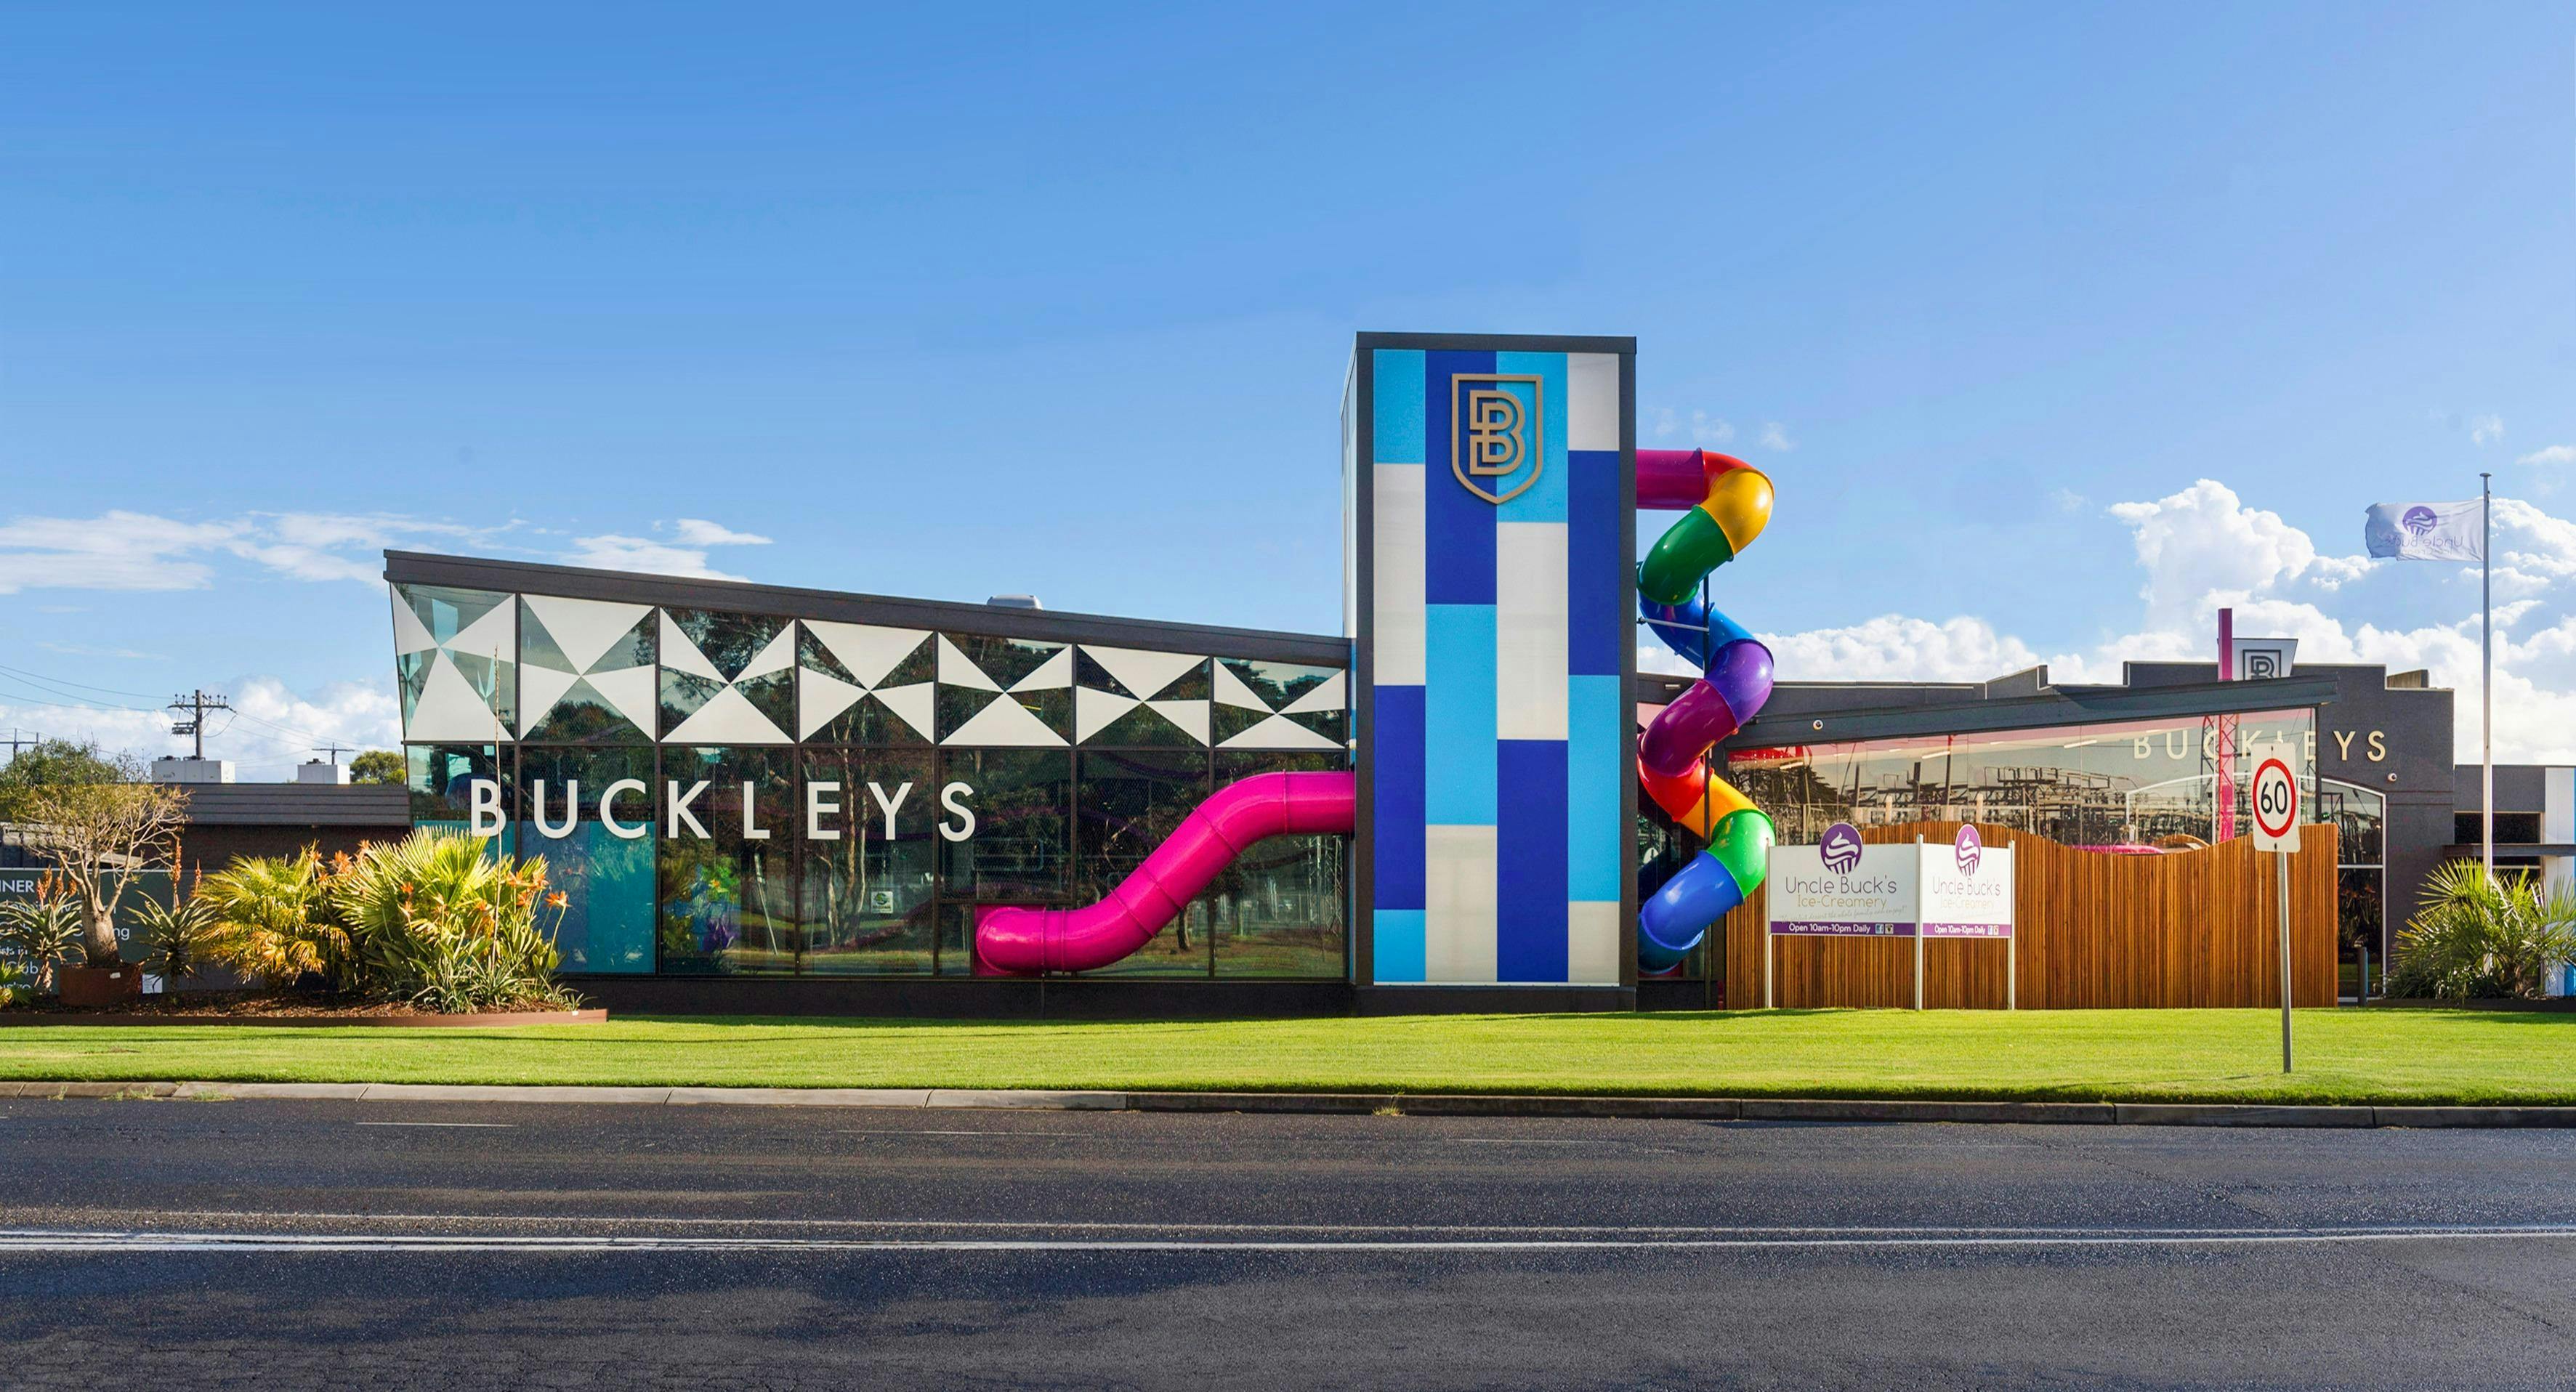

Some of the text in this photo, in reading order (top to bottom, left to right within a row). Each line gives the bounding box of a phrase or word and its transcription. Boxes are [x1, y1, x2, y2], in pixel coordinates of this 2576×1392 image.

[2260, 780, 2288, 815] 60
[469, 778, 976, 841] BUCKLEYS
[0, 880, 35, 893] NER
[1785, 875, 1897, 894] Uncle Buck's
[1933, 876, 2000, 896] Uncle Buck's
[1798, 894, 1887, 909] Ice-Creamery
[1788, 923, 1870, 934] Open 10am-10pm Daily
[1934, 925, 1947, 935] Open
[1974, 926, 1986, 935] Daily
